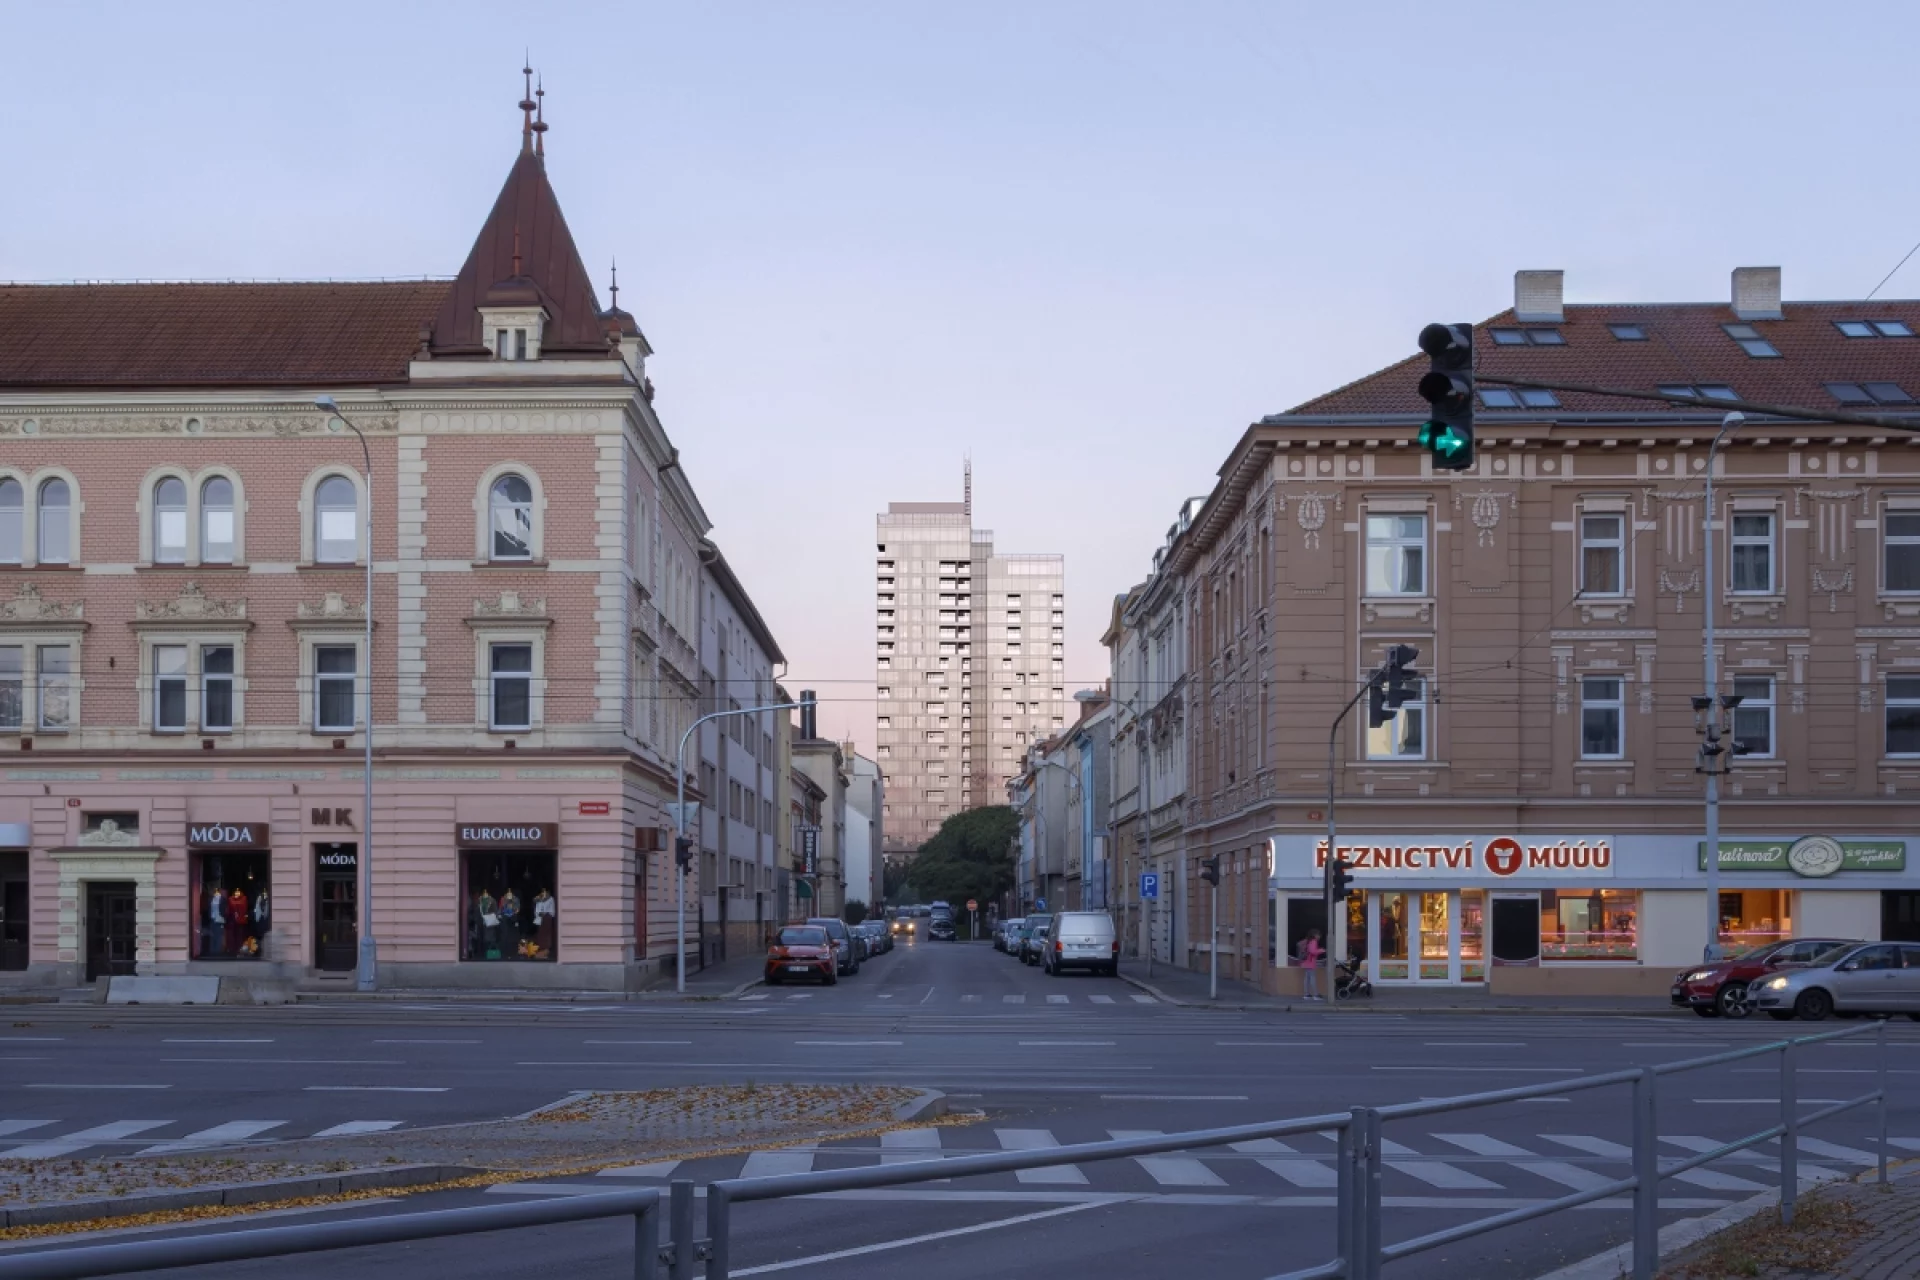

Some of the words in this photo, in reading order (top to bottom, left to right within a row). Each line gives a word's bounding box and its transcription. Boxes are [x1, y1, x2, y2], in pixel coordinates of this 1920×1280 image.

[189, 822, 252, 843] MÓDA
[462, 826, 542, 840] EUROMILO
[319, 852, 356, 865] MÓDA
[1316, 840, 1473, 868] ŘEZNICTVÍ
[1527, 840, 1611, 868] MÚÚÚ
[1145, 876, 1155, 891] P
